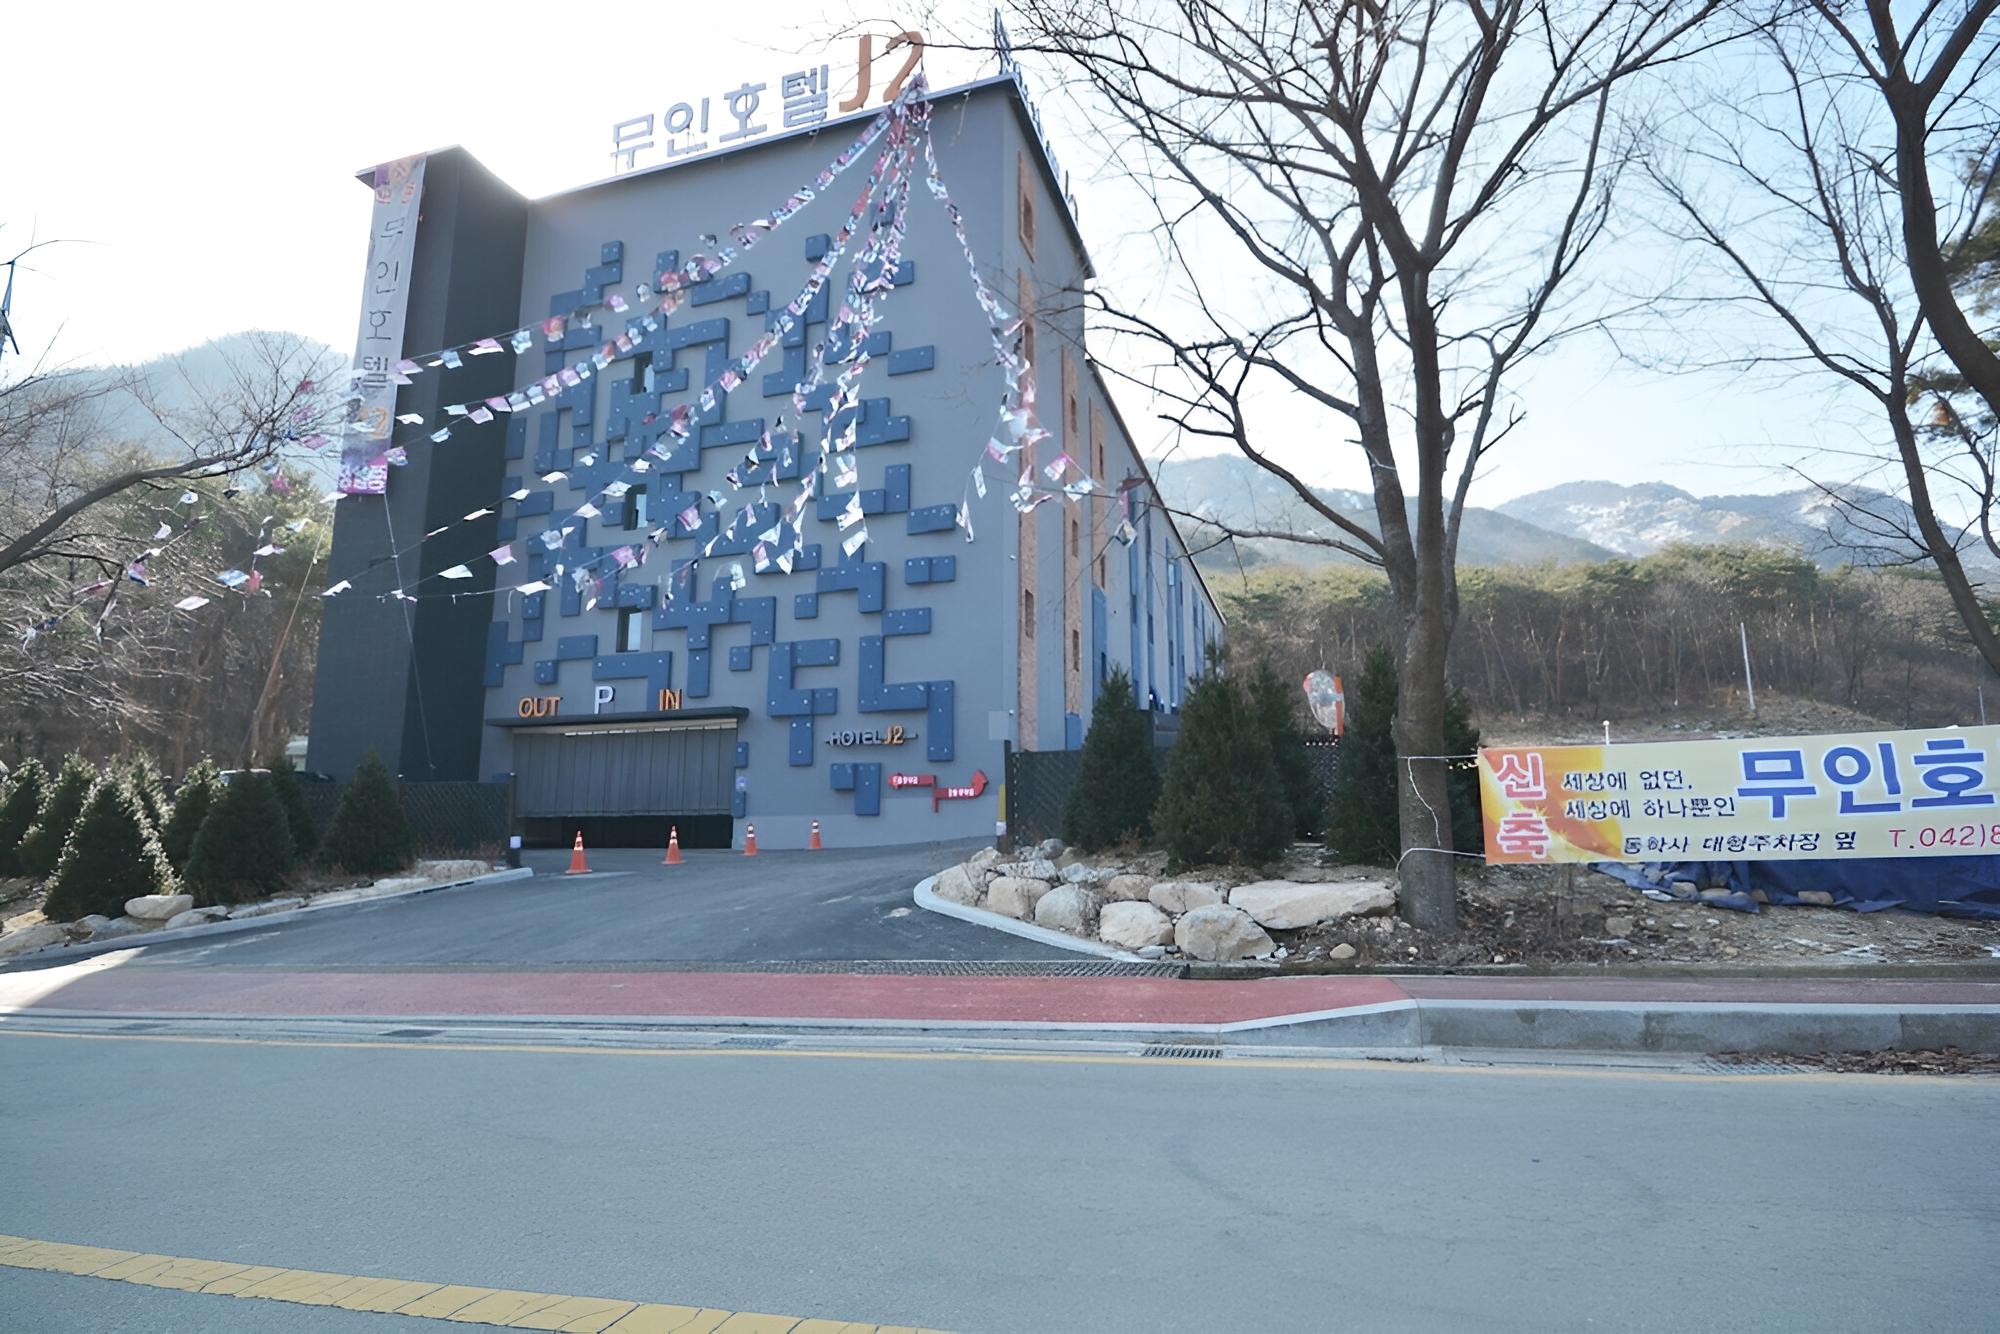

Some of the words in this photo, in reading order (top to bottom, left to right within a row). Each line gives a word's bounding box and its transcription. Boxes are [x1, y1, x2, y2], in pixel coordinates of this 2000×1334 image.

[610, 64, 829, 169] 무인호텔
[839, 31, 924, 113] J2
[518, 696, 562, 718] OUT
[593, 685, 616, 715] P
[658, 688, 682, 711] IN
[829, 727, 882, 746] HOTEL
[883, 725, 905, 745] J2
[1564, 771, 1628, 791] 세상에
[1640, 770, 1693, 790] 없던.
[1497, 753, 1549, 856] 신축
[1566, 799, 1631, 818] 세상에
[1643, 797, 1735, 818] 하나뿐인
[1834, 831, 1857, 850] 옆
